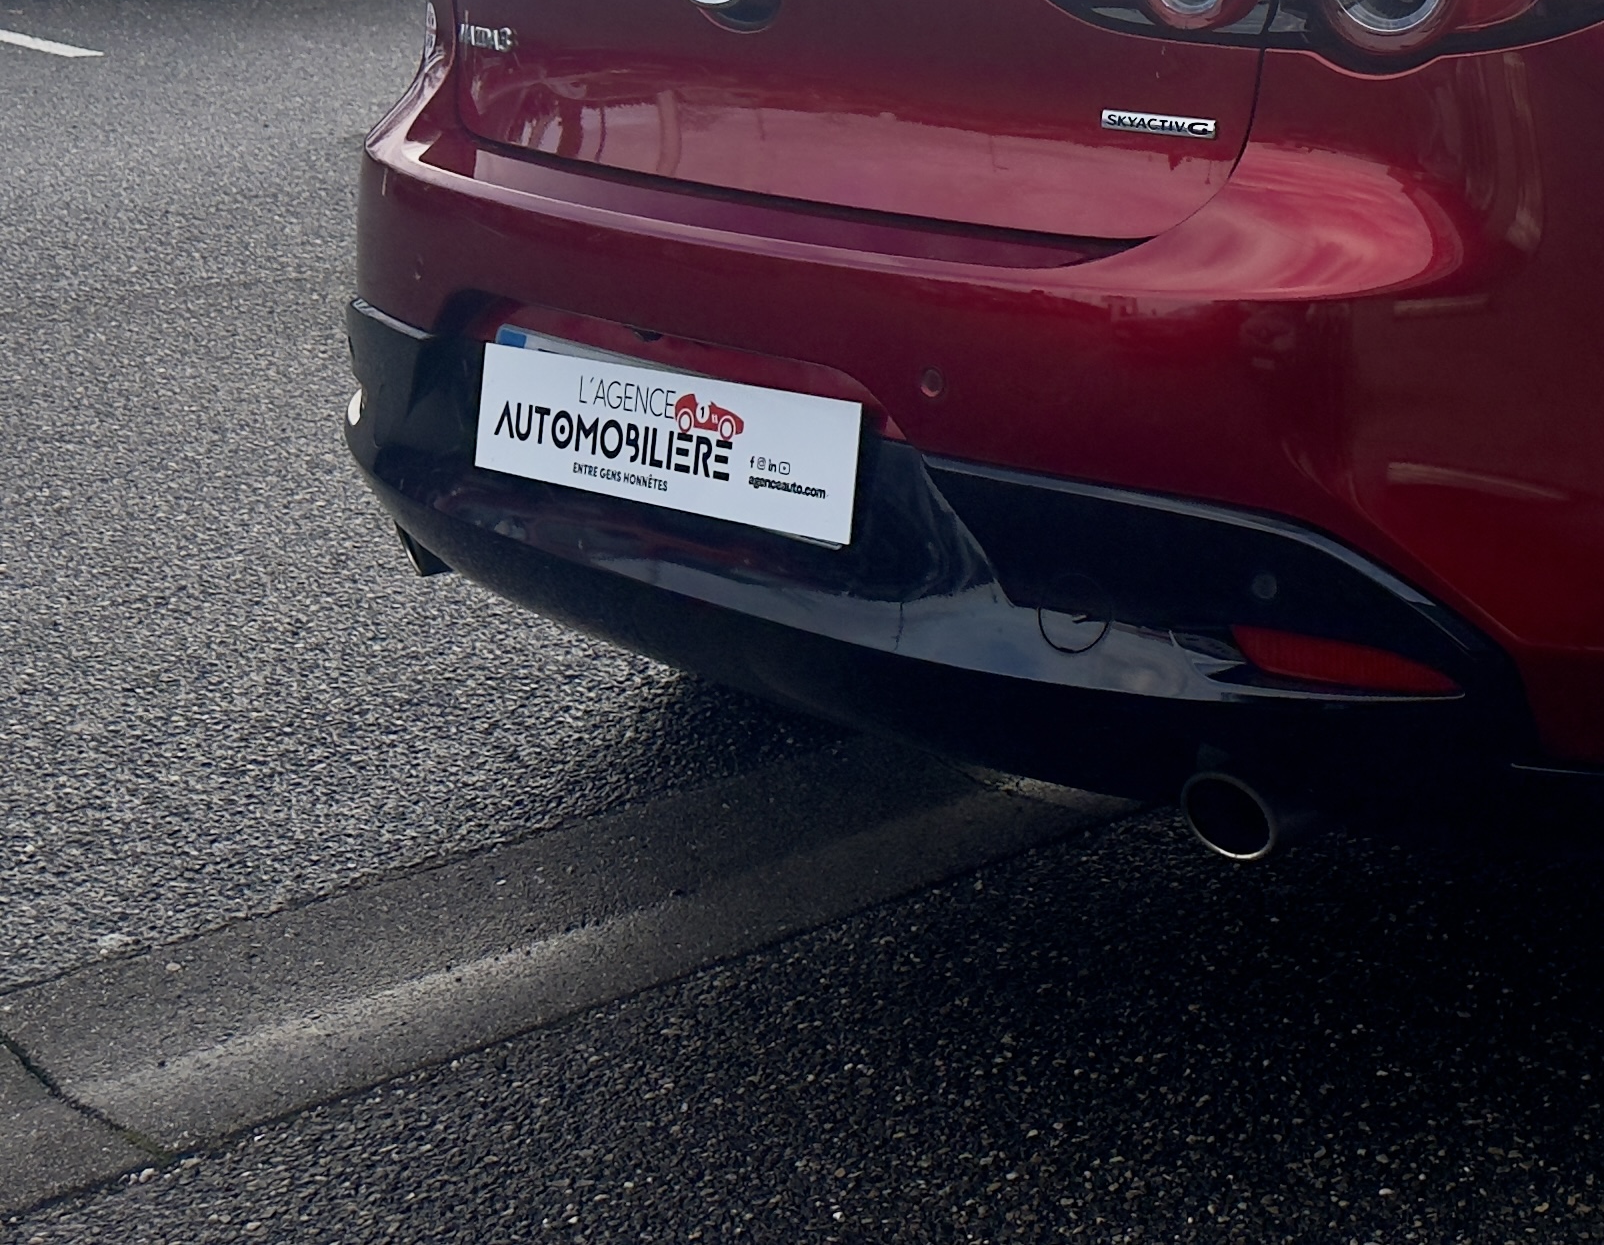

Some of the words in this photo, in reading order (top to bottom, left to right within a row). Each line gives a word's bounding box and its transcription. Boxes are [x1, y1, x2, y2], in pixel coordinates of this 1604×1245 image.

[579, 375, 676, 420] L'AGENCE
[573, 462, 598, 477] ENTRE
[600, 469, 621, 483] GENS
[623, 473, 668, 492] HONNÊTES
[749, 475, 826, 500] agenceauto.com
